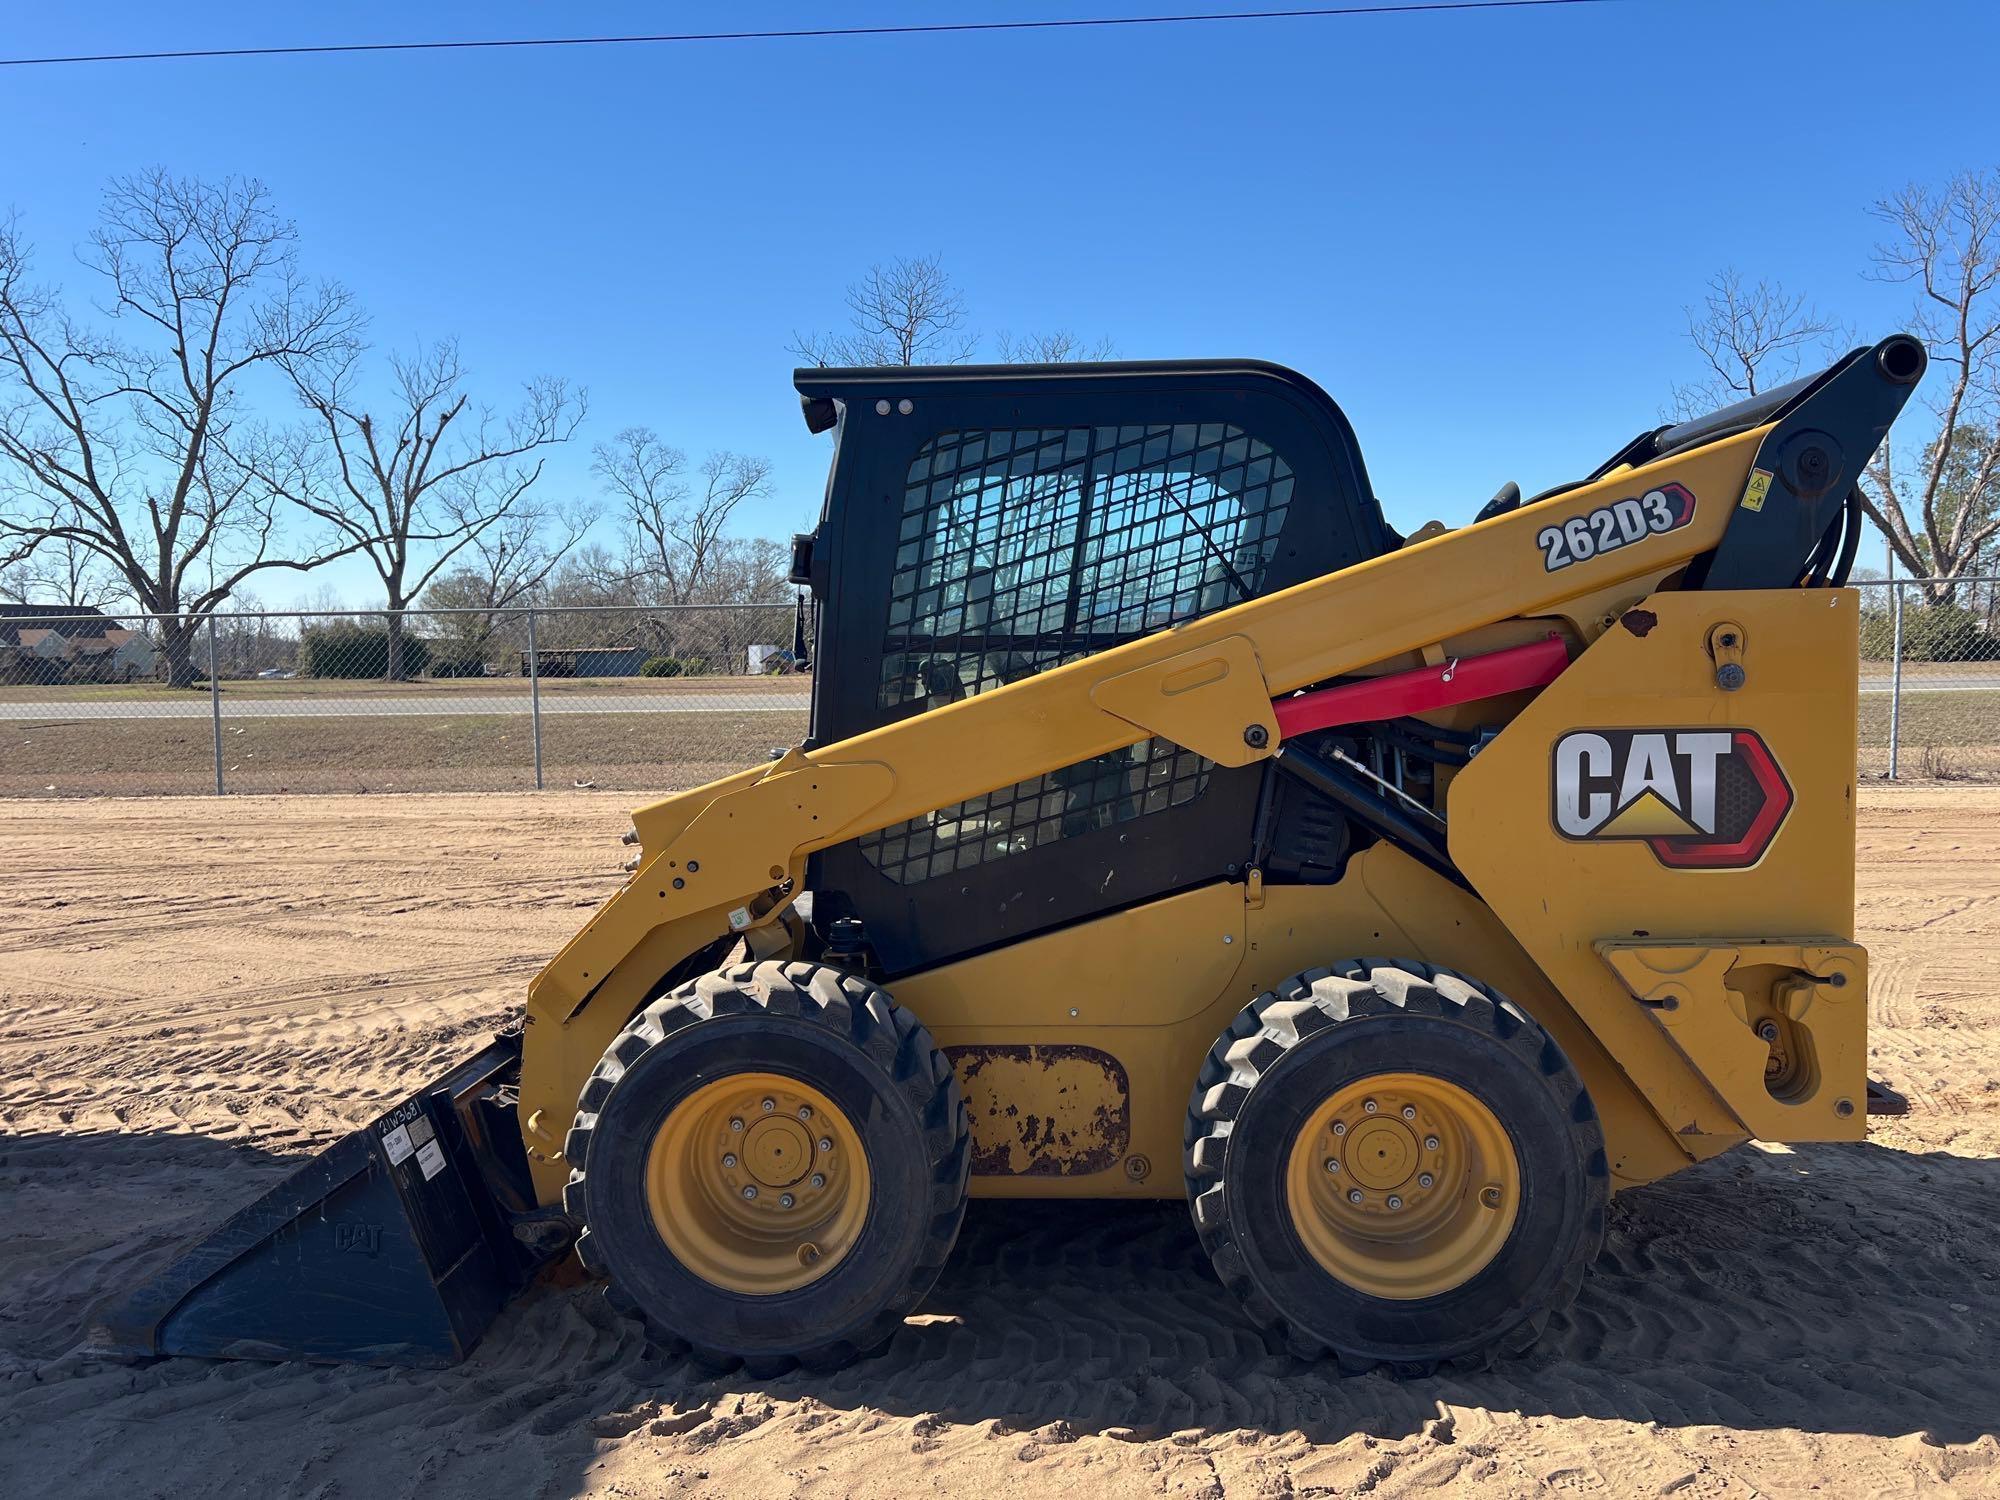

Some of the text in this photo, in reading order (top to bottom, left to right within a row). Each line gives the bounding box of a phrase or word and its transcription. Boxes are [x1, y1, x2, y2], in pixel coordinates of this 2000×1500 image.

[1538, 491, 1674, 570] 262D3
[1556, 732, 1732, 836] CAT
[335, 1223, 384, 1252] CAT
